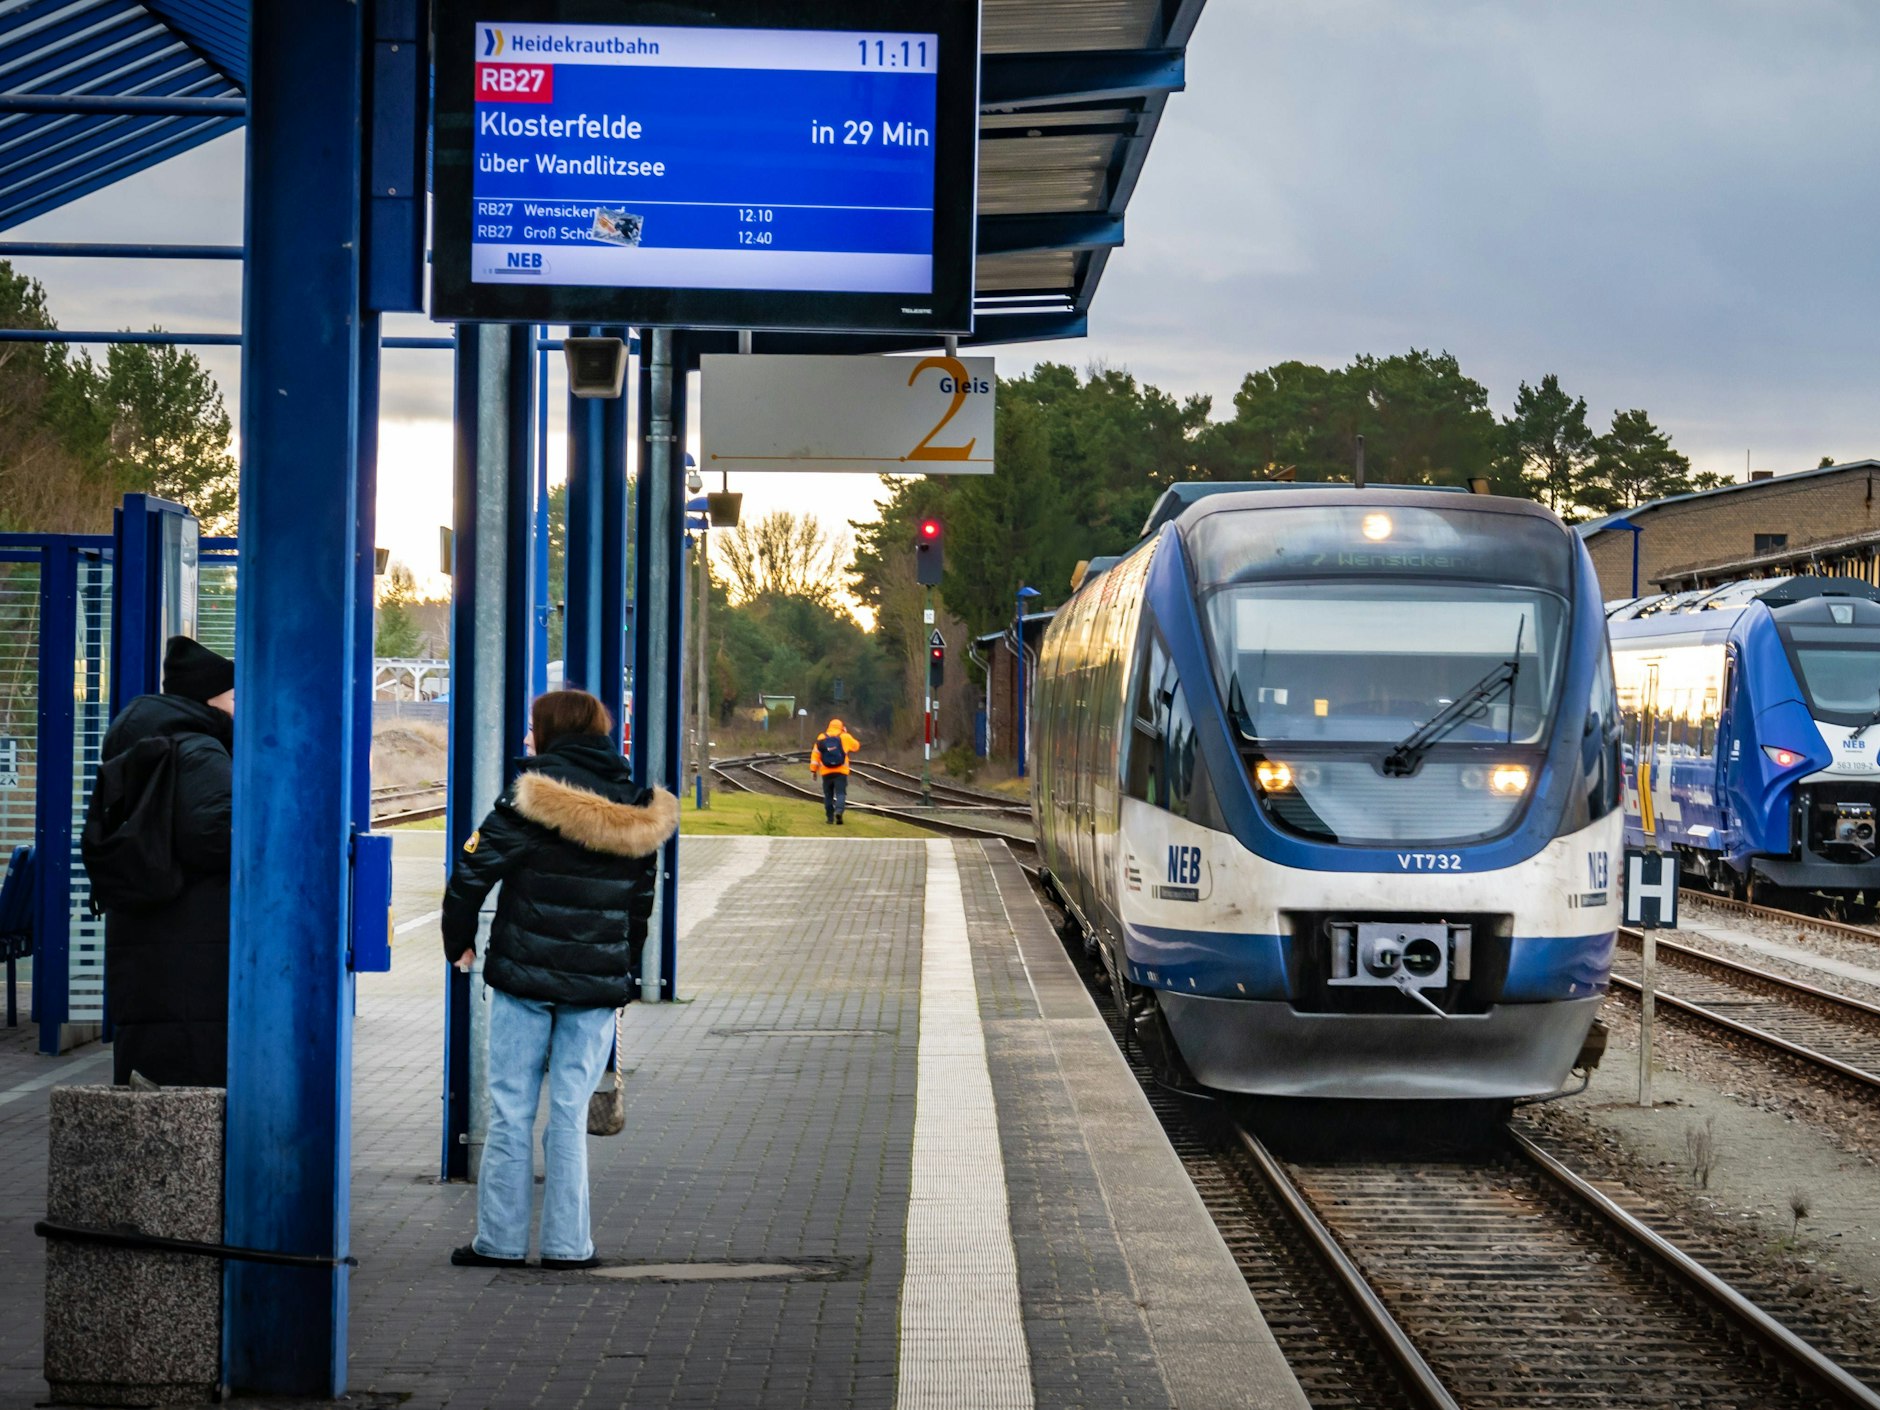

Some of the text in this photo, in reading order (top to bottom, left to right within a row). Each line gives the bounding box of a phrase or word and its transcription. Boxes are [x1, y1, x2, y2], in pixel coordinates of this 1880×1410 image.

[511, 35, 660, 55] Heidekrautbahn
[858, 39, 926, 67] 11:11
[481, 68, 545, 93] RB27
[480, 111, 642, 139] Klosterfelde
[811, 119, 929, 147] in 29 Min
[479, 153, 665, 176] über Wandlitzsee
[478, 203, 625, 218] RB27 Wensicken
[739, 208, 773, 222] 12:10
[477, 225, 513, 238] RB27
[523, 226, 556, 239] Groß
[738, 231, 773, 245] 12:40
[507, 252, 542, 268] NEB
[939, 377, 989, 394] Gleis
[908, 356, 976, 461] 2
[1842, 739, 1866, 750] NEB
[1167, 845, 1201, 885] NEB
[1397, 854, 1462, 870] VT732
[1588, 851, 1608, 889] NEB
[1628, 856, 1675, 922] H
